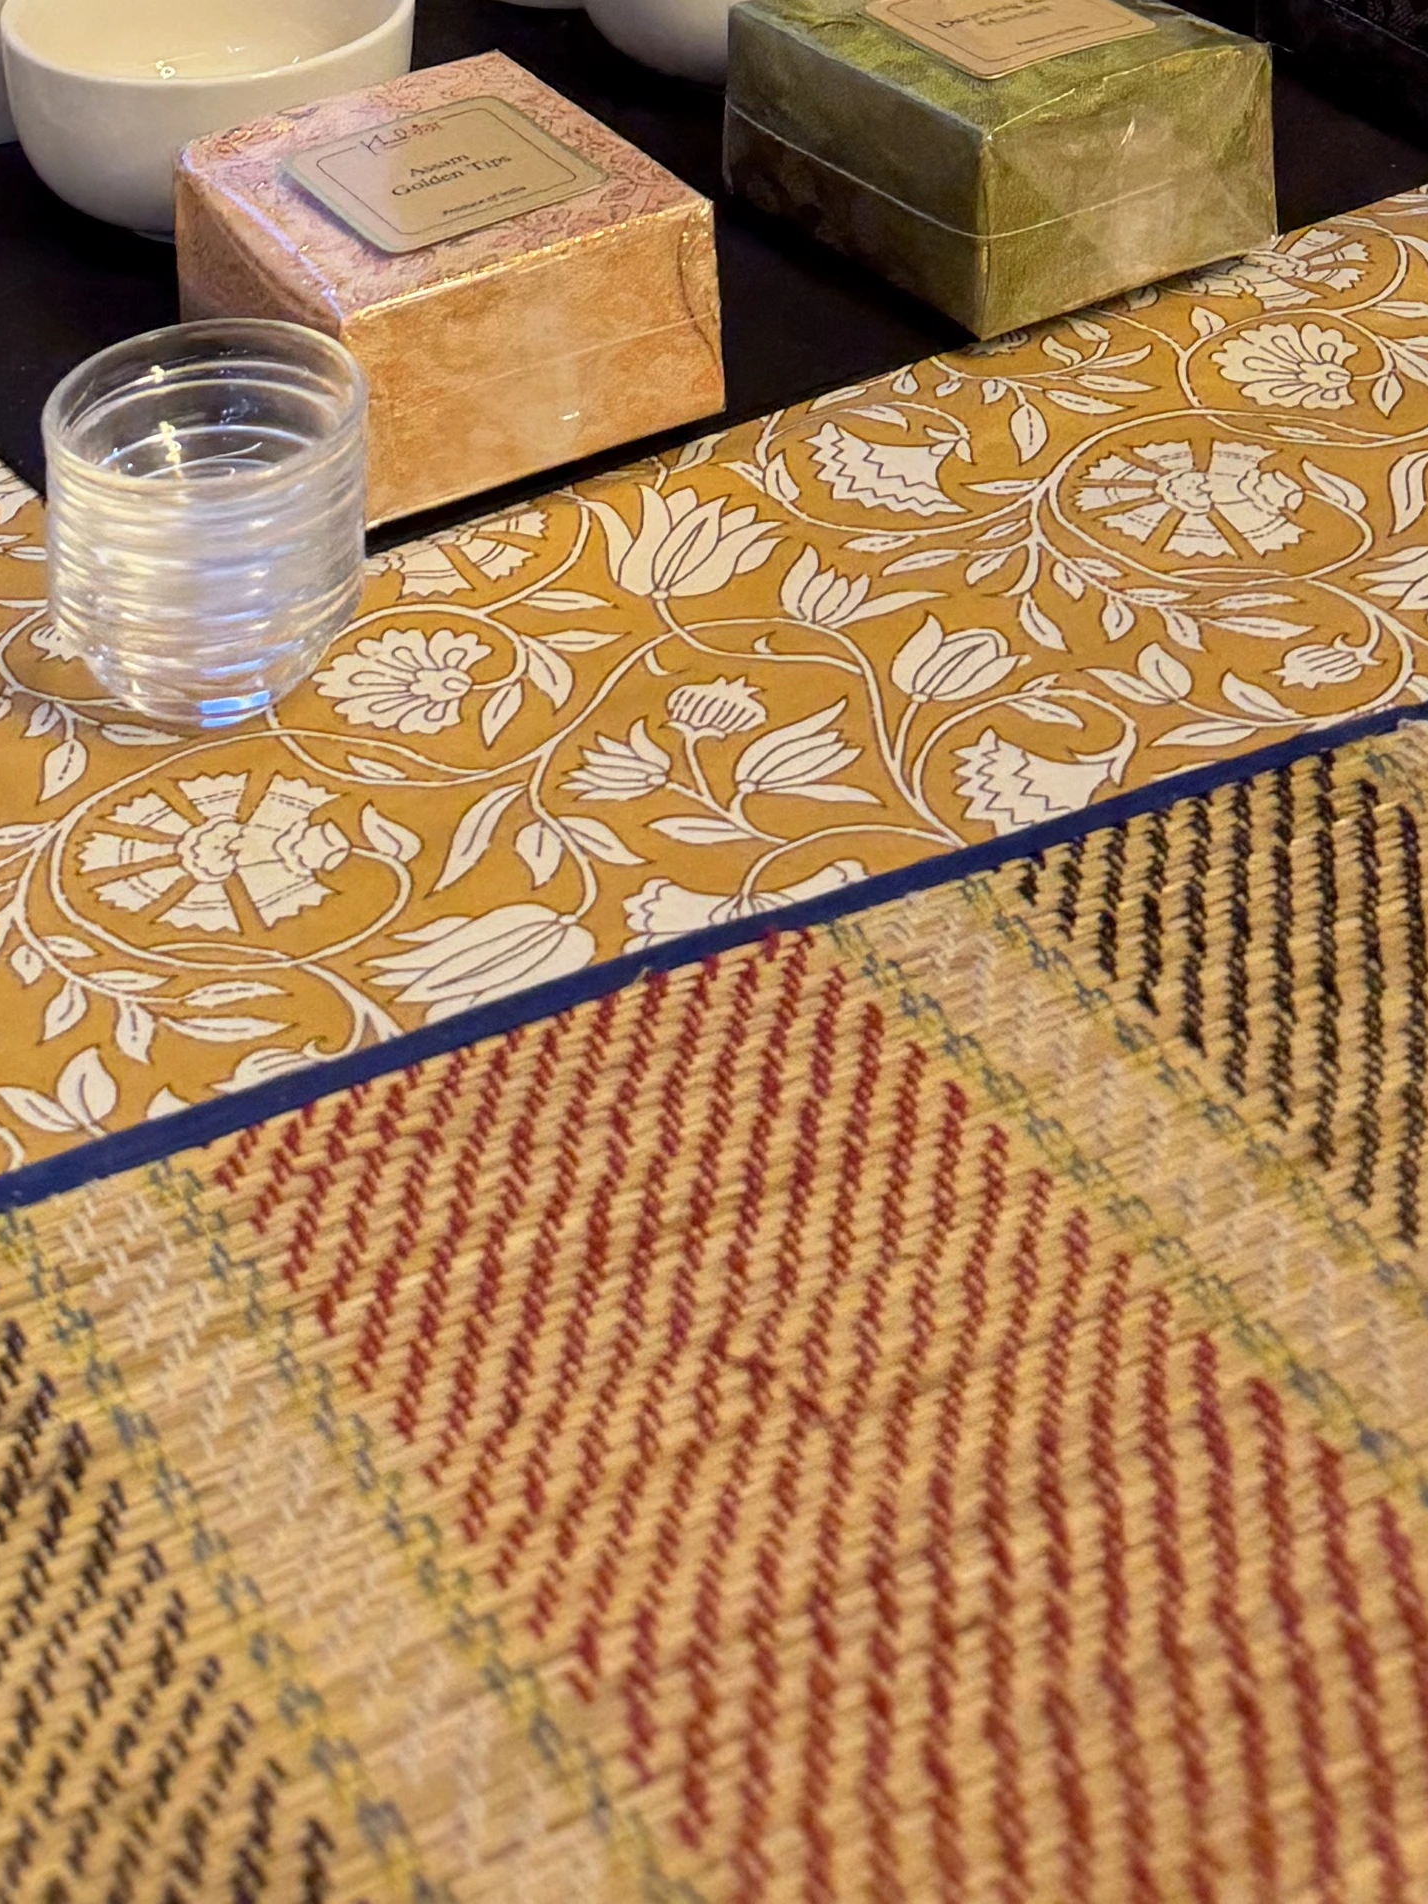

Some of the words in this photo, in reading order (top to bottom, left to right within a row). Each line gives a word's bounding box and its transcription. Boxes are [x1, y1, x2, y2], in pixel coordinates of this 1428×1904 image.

[391, 169, 465, 197] Golden
[466, 154, 513, 173] Tips
[409, 153, 470, 177] Assam
